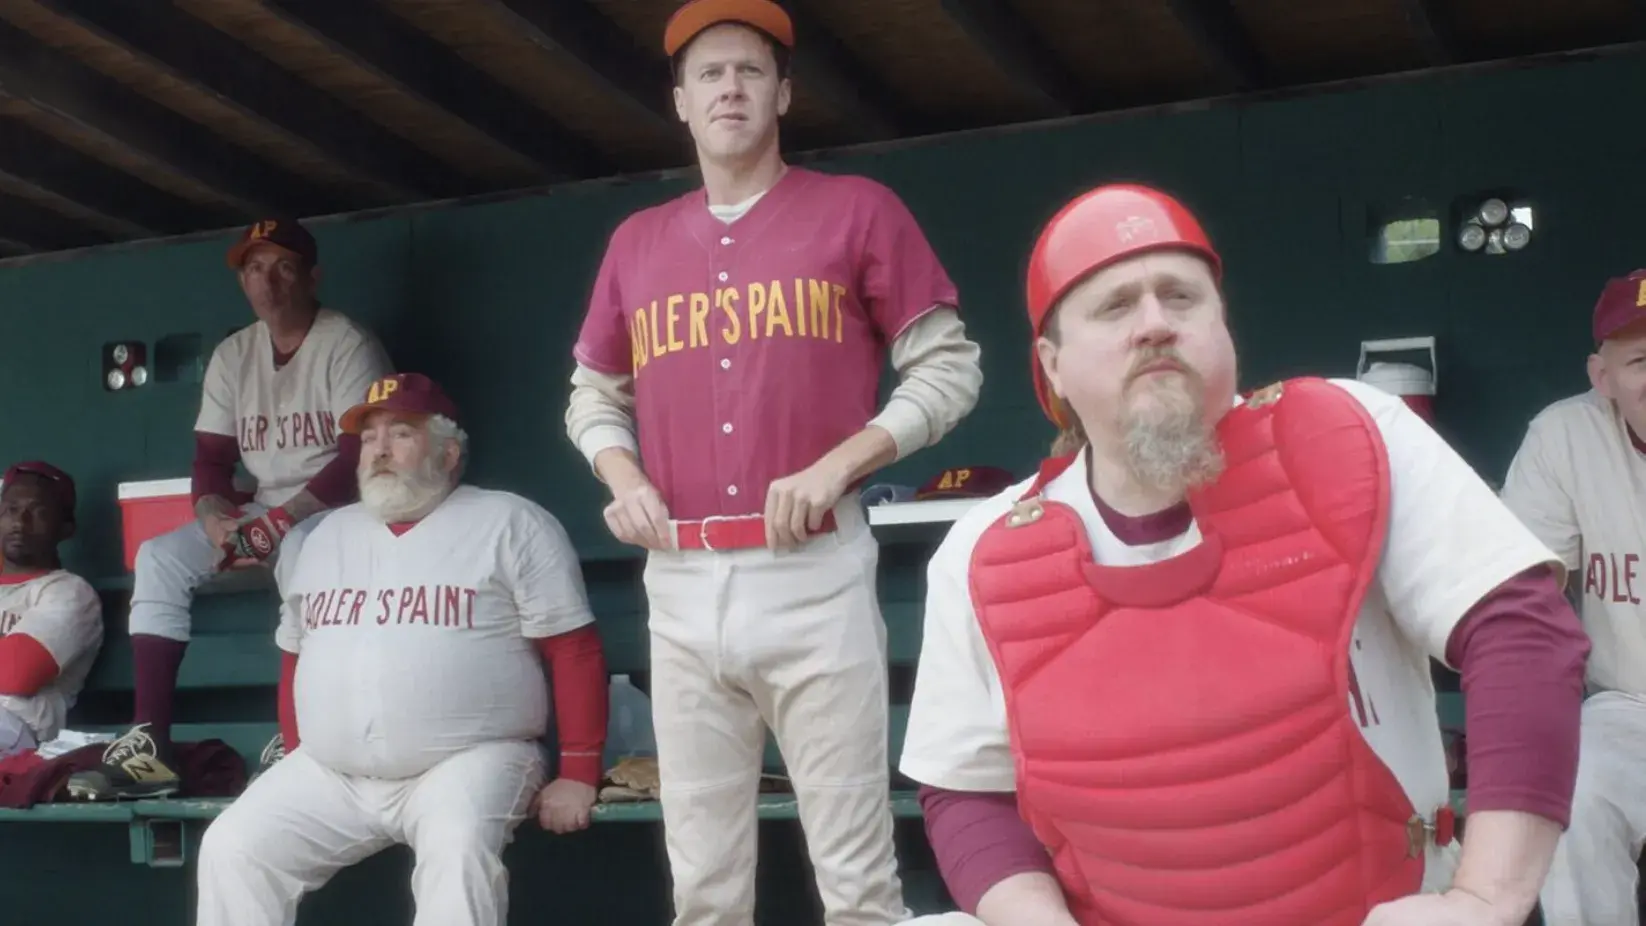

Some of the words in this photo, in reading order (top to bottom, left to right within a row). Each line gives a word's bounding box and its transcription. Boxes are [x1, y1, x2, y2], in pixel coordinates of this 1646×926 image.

[251, 220, 278, 240] AP
[630, 286, 741, 379] ADLER'S
[748, 277, 846, 344] PAINT
[367, 379, 399, 404] AP
[241, 414, 289, 453] LER'S
[292, 410, 337, 449] PAIN
[937, 468, 971, 490] AP
[1585, 552, 1642, 606] ADLE
[396, 585, 477, 630] PAINT
